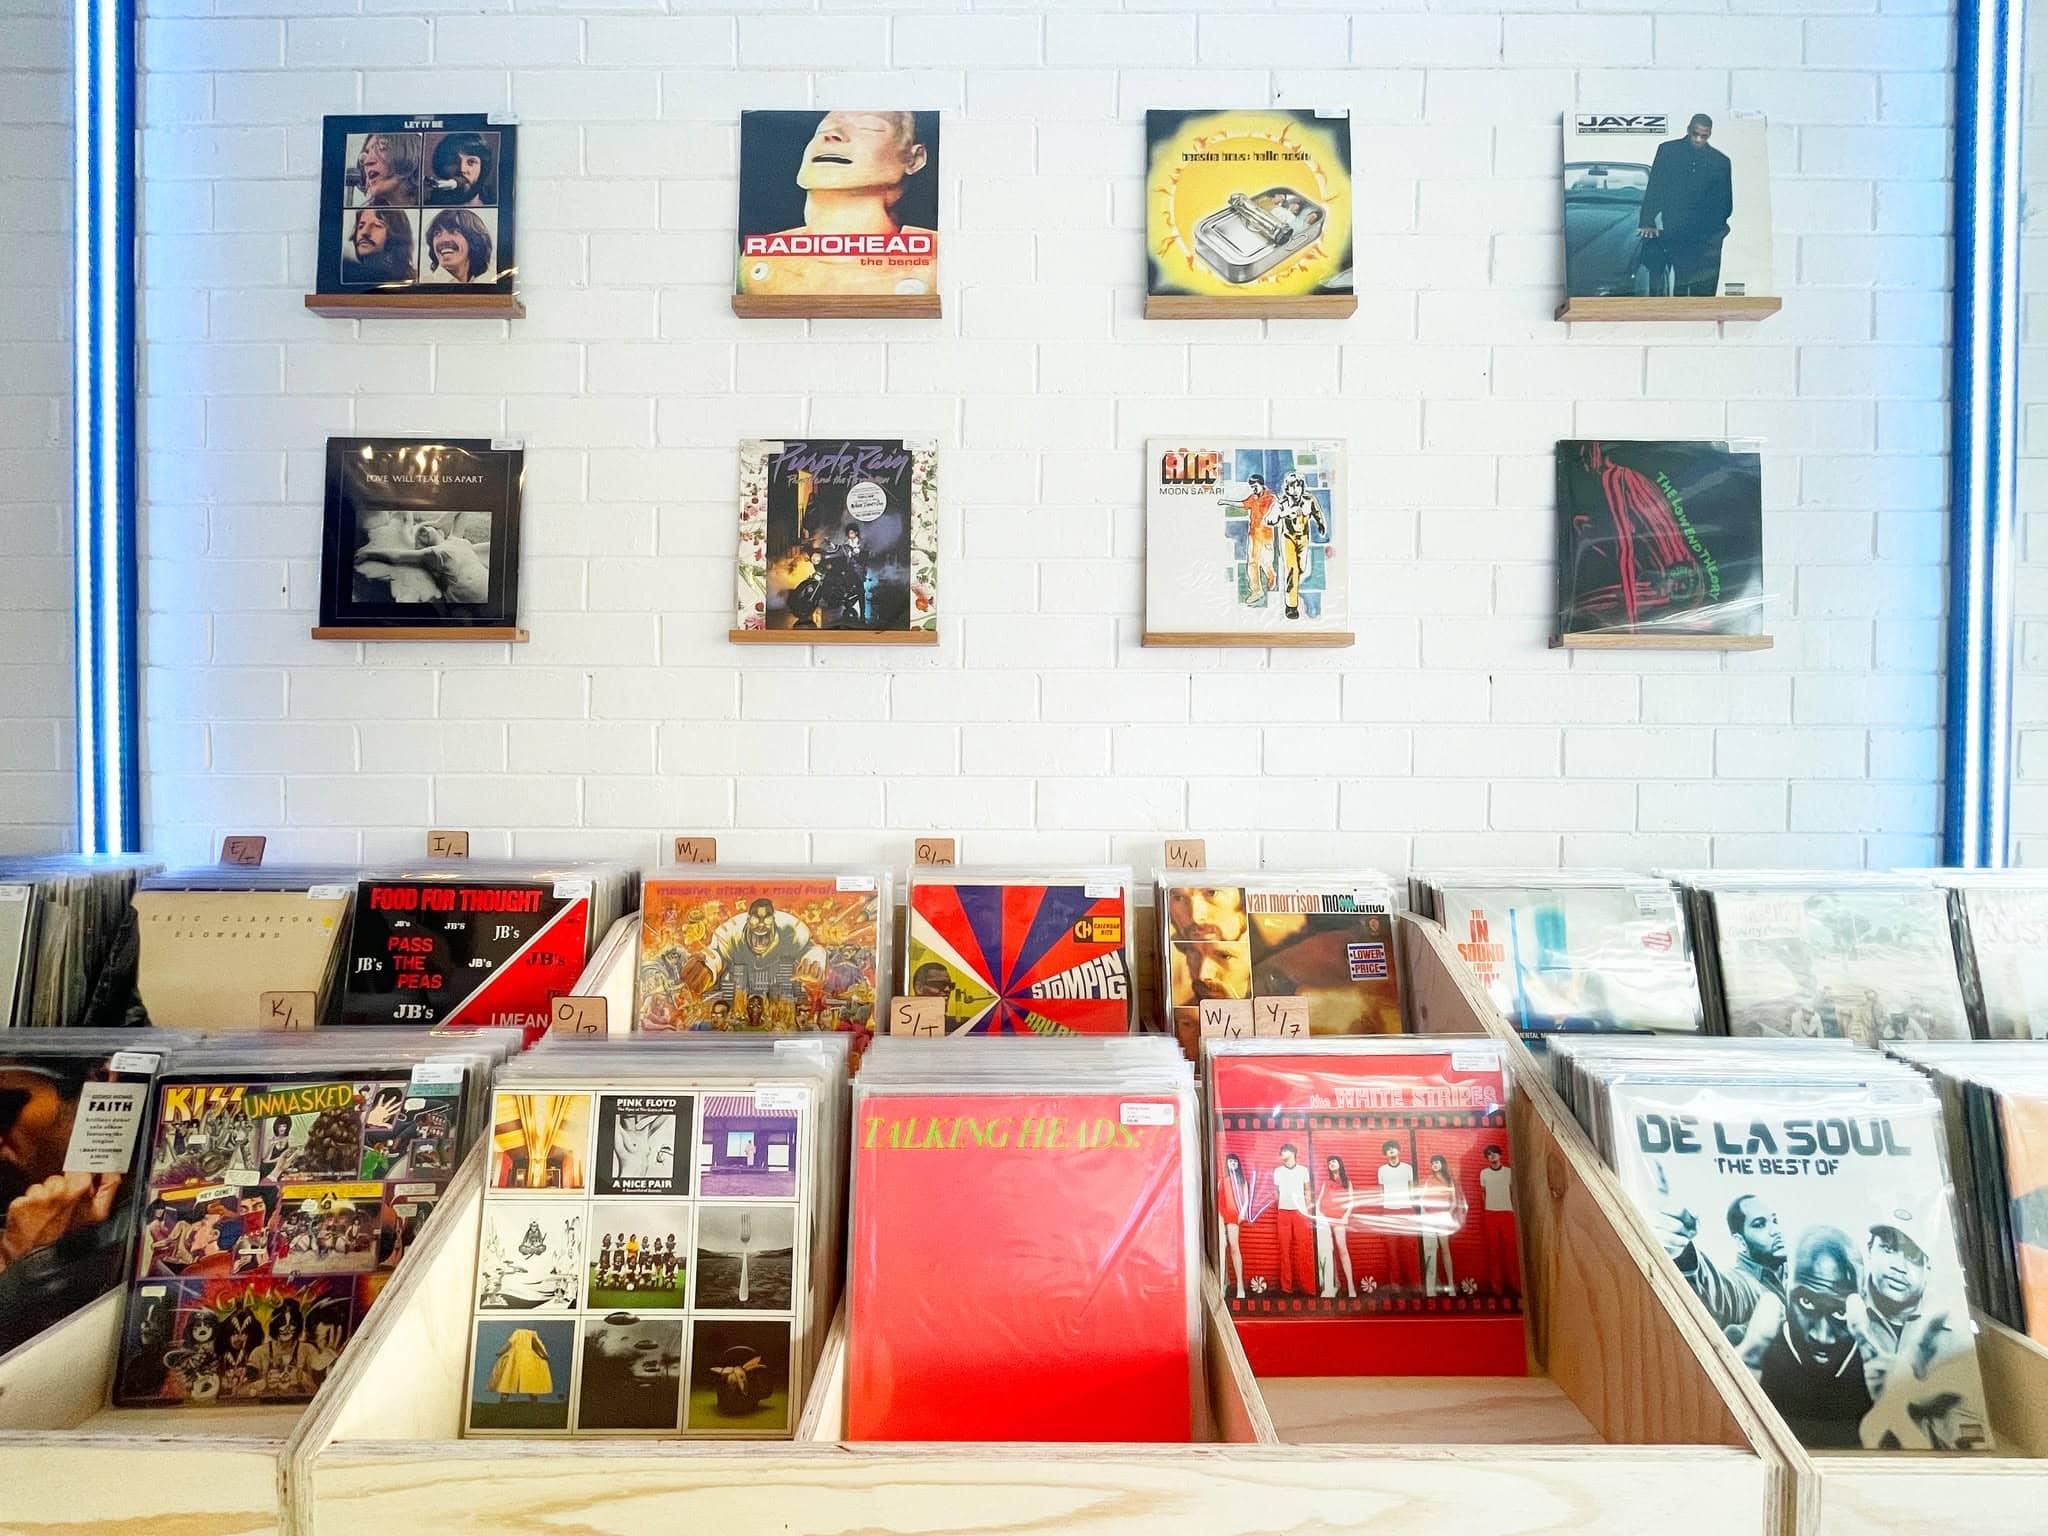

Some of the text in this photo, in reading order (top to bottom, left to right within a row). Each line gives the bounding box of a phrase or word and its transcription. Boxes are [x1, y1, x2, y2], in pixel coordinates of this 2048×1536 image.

[404, 121, 420, 129] LET
[421, 121, 430, 129] IT
[1578, 116, 1665, 127] JAY-Z
[747, 235, 931, 255] RADIOHEAD
[860, 257, 930, 266] the bends
[772, 442, 909, 486] Purple Rain
[1161, 450, 1219, 485] AIR
[366, 475, 389, 483] LOVE
[392, 475, 415, 483] WILL
[442, 475, 453, 483] US
[455, 475, 484, 484] APART
[1159, 487, 1225, 496] MOON SAFARI
[1656, 471, 1721, 600] THE LOW END THEORY
[370, 887, 418, 911] FOOD
[420, 888, 456, 911] FOR
[459, 889, 543, 913] THOUGHT
[1246, 894, 1267, 913] van
[1269, 893, 1321, 913] morrison
[493, 925, 520, 941] JB's
[1469, 919, 1489, 943] IN
[388, 936, 433, 952] PASS
[1352, 949, 1381, 960] LOWER
[1457, 943, 1505, 962] SOUND
[354, 957, 383, 974] JB's
[393, 955, 426, 971] THE
[468, 958, 493, 968] JB's
[1354, 963, 1381, 974] PRICE
[397, 973, 443, 990] PEAS
[393, 1004, 434, 1020] JB's
[491, 1012, 548, 1028] I MEAN
[164, 1084, 353, 1123] KISS UNMASKED
[616, 1098, 677, 1108] PINK FLOYD
[1310, 1085, 1497, 1108] the WHITE STRIPES
[89, 1101, 133, 1112] FAITH
[864, 1116, 1013, 1150] TALKING
[1636, 1114, 1912, 1157] DE LA SOUL
[1714, 1157, 1840, 1176] THE BEST OF
[612, 1179, 673, 1189] A NICE PAIR
